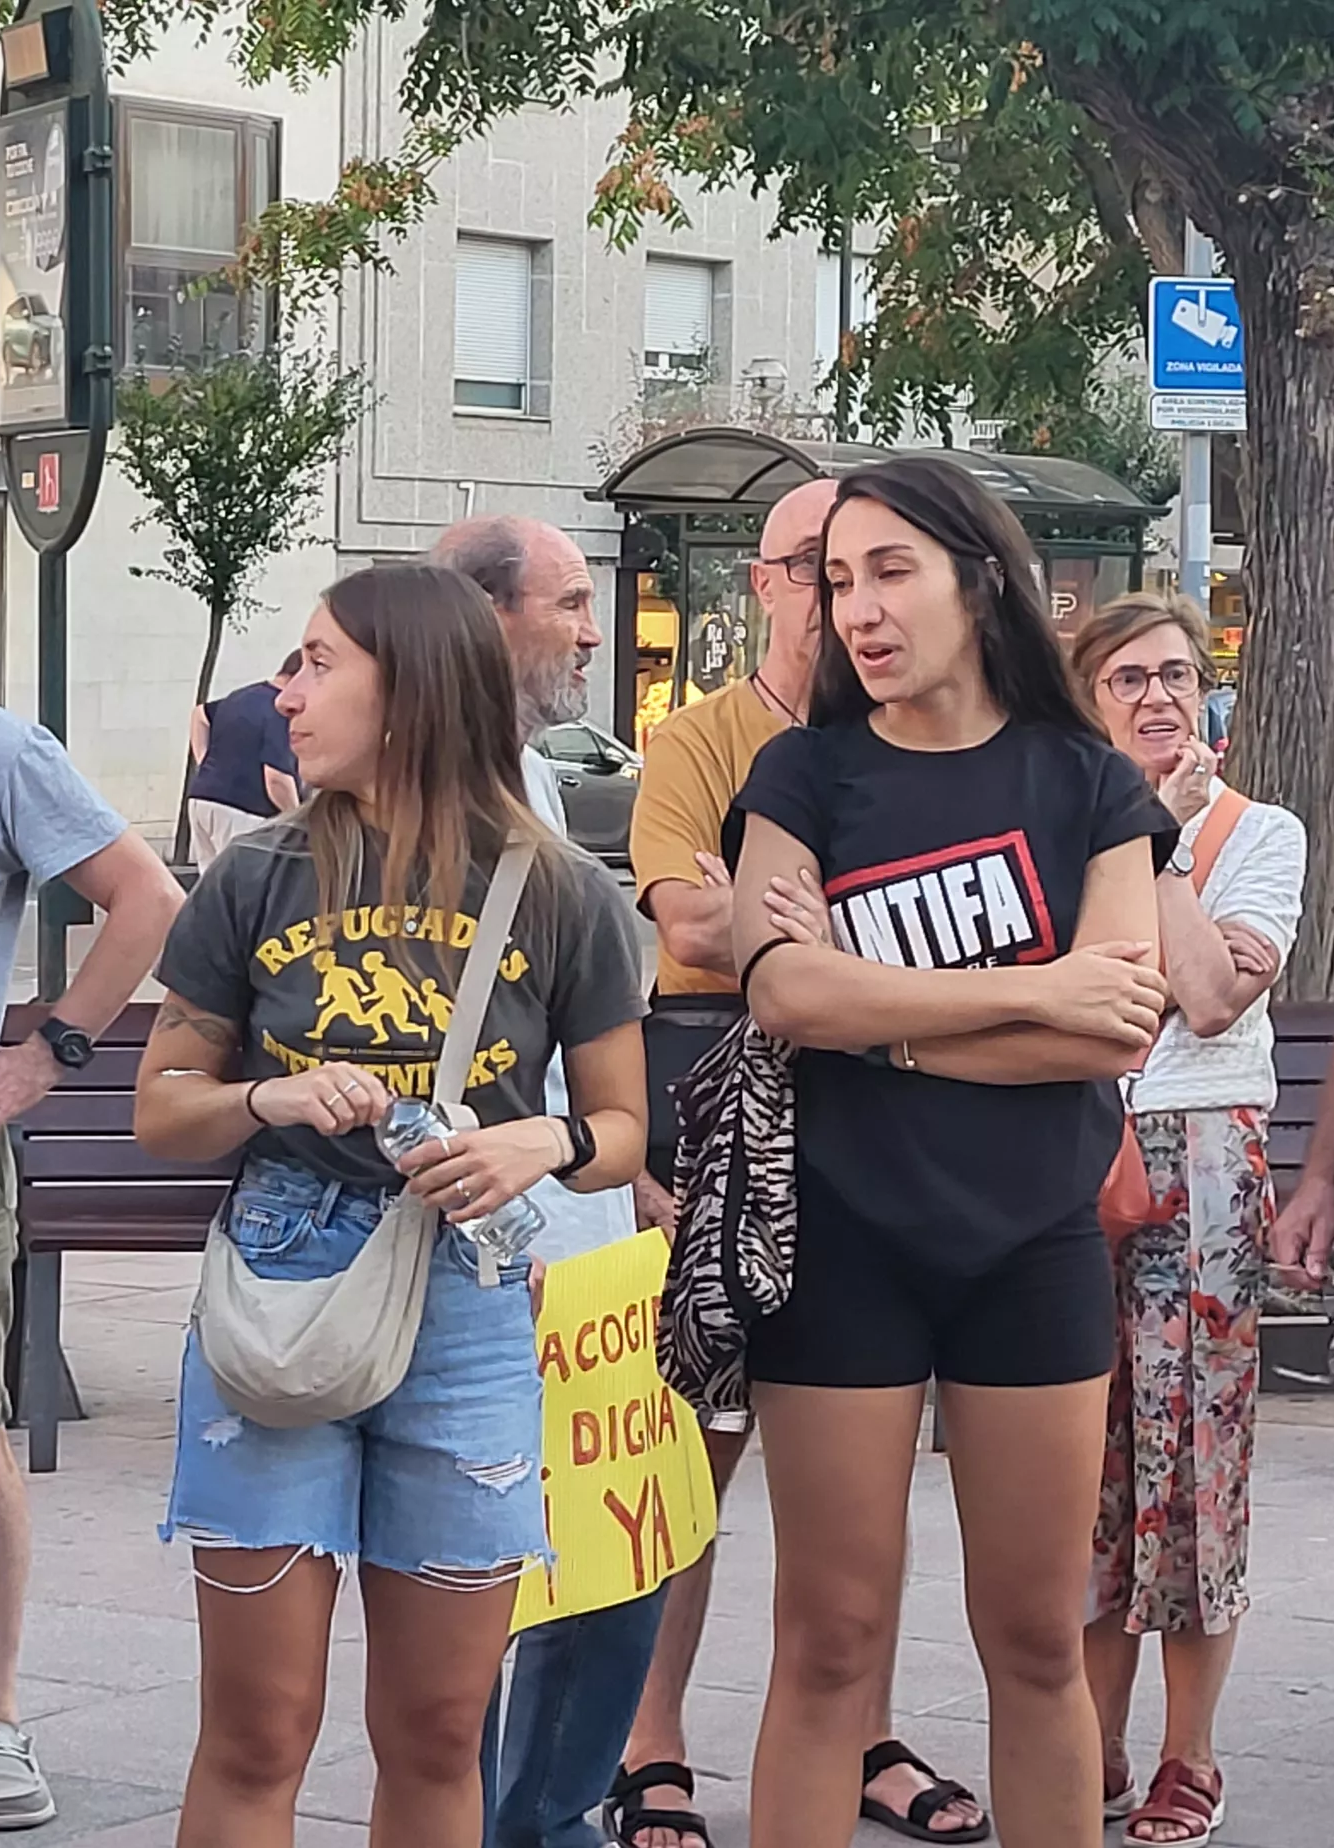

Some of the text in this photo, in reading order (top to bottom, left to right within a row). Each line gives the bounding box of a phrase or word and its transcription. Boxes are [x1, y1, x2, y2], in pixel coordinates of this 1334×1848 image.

[1165, 361, 1244, 374] ZONA VIGILADA
[572, 1385, 677, 1466] DIGNA
